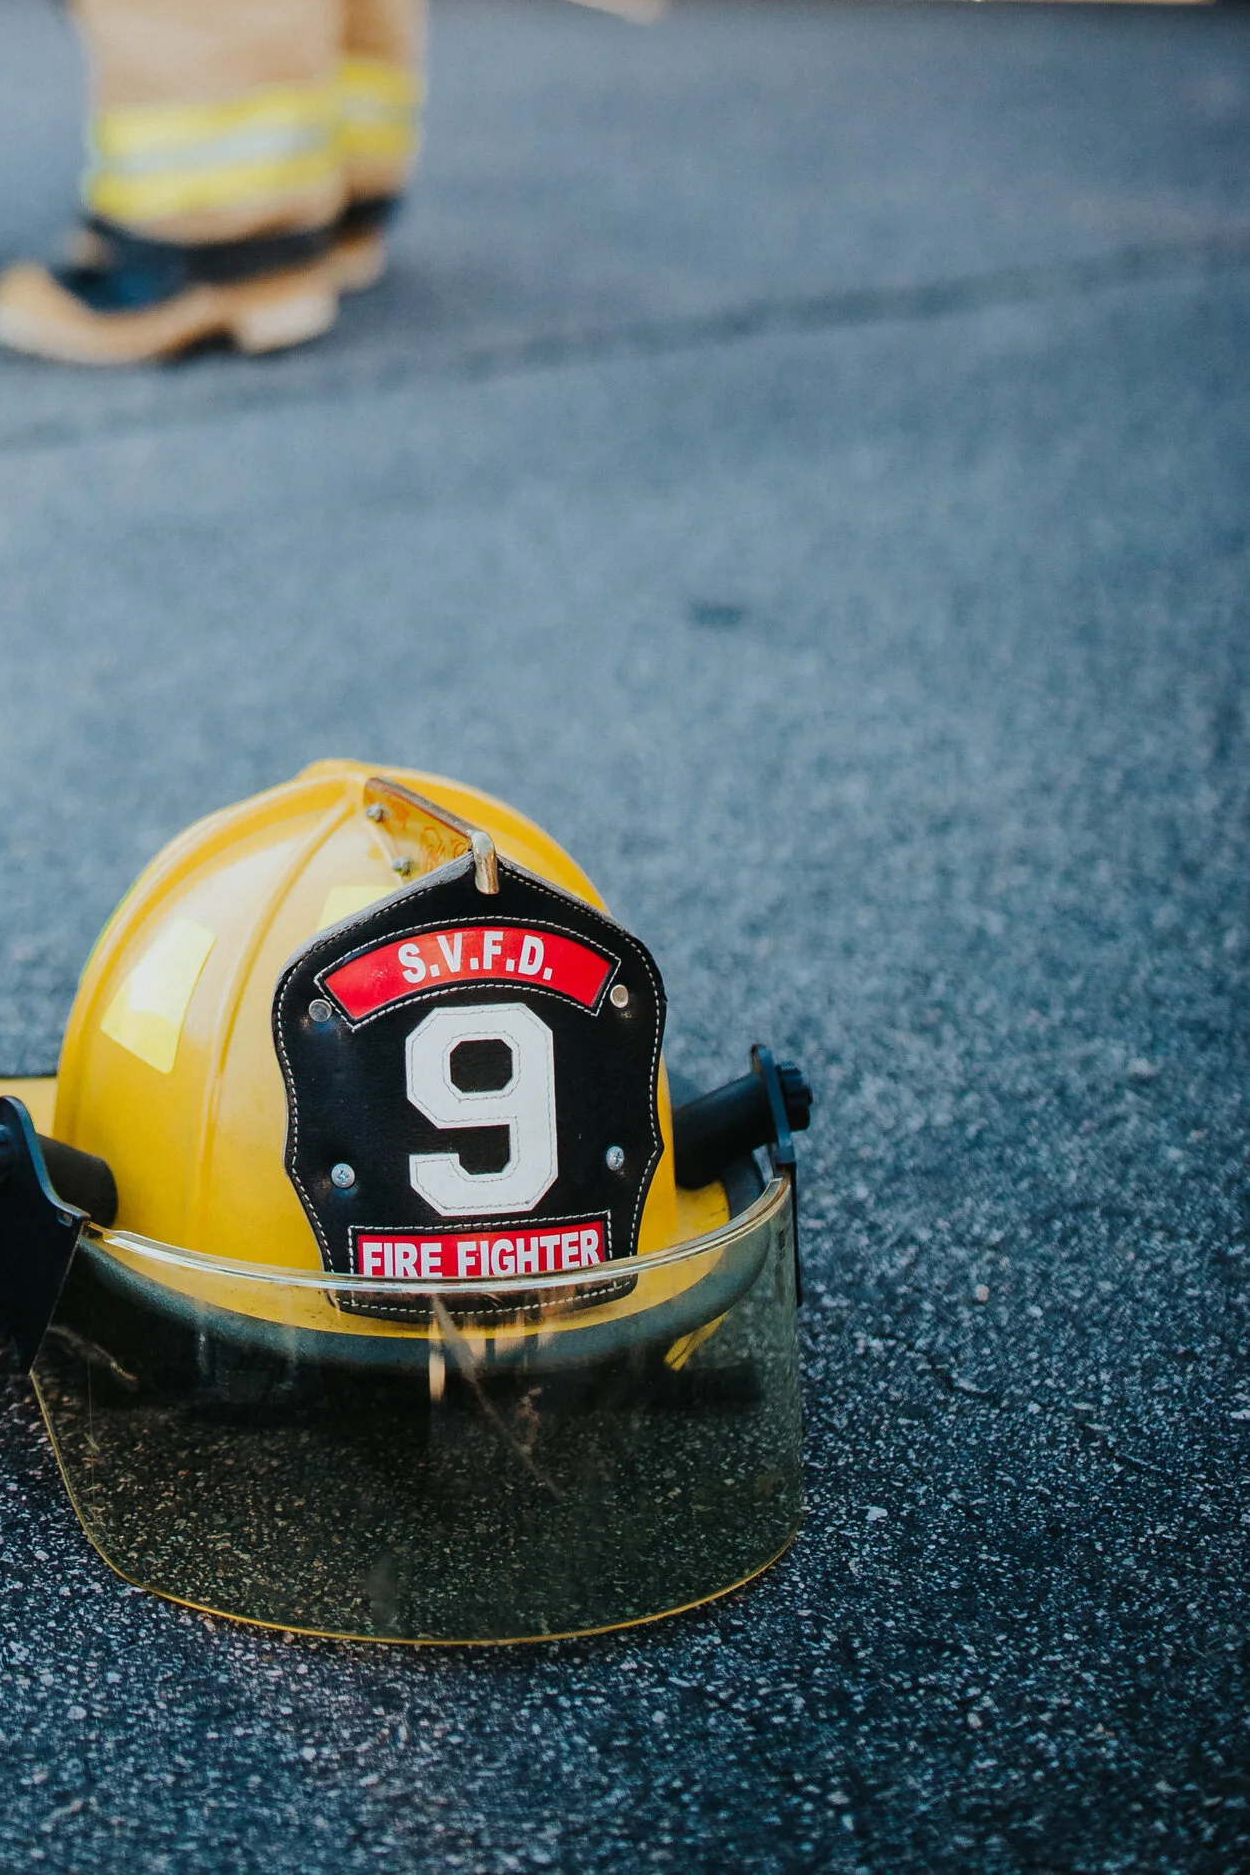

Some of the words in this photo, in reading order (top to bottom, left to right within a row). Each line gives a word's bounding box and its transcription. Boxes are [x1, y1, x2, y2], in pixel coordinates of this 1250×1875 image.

[397, 930, 554, 984] S.V.F.D.
[405, 1002, 559, 1217] 9
[362, 1241, 444, 1278] FIRE
[456, 1228, 602, 1278] FIGHTER
